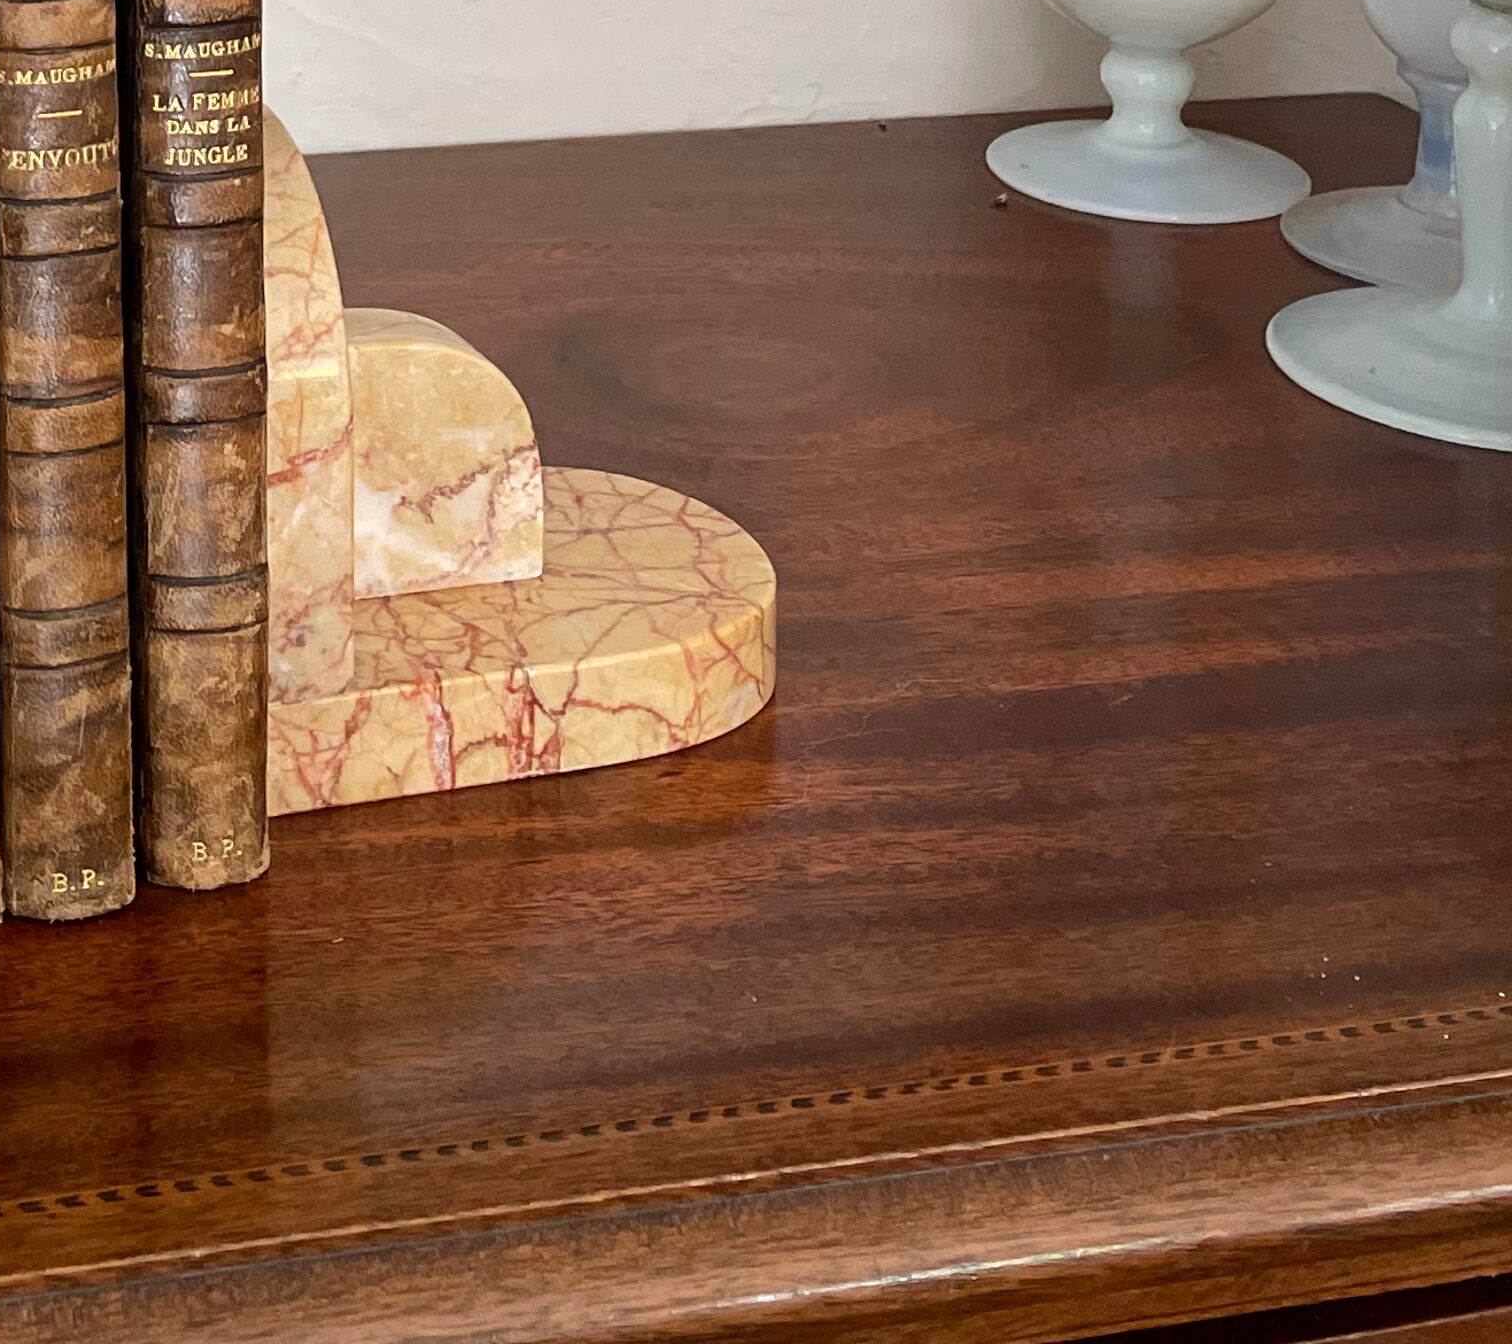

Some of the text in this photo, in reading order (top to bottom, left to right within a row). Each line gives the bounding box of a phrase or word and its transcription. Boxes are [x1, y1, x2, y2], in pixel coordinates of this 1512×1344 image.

[152, 86, 260, 112] LA FEMME
[166, 115, 252, 135] DANS LA
[164, 143, 249, 166] JUNGLE
